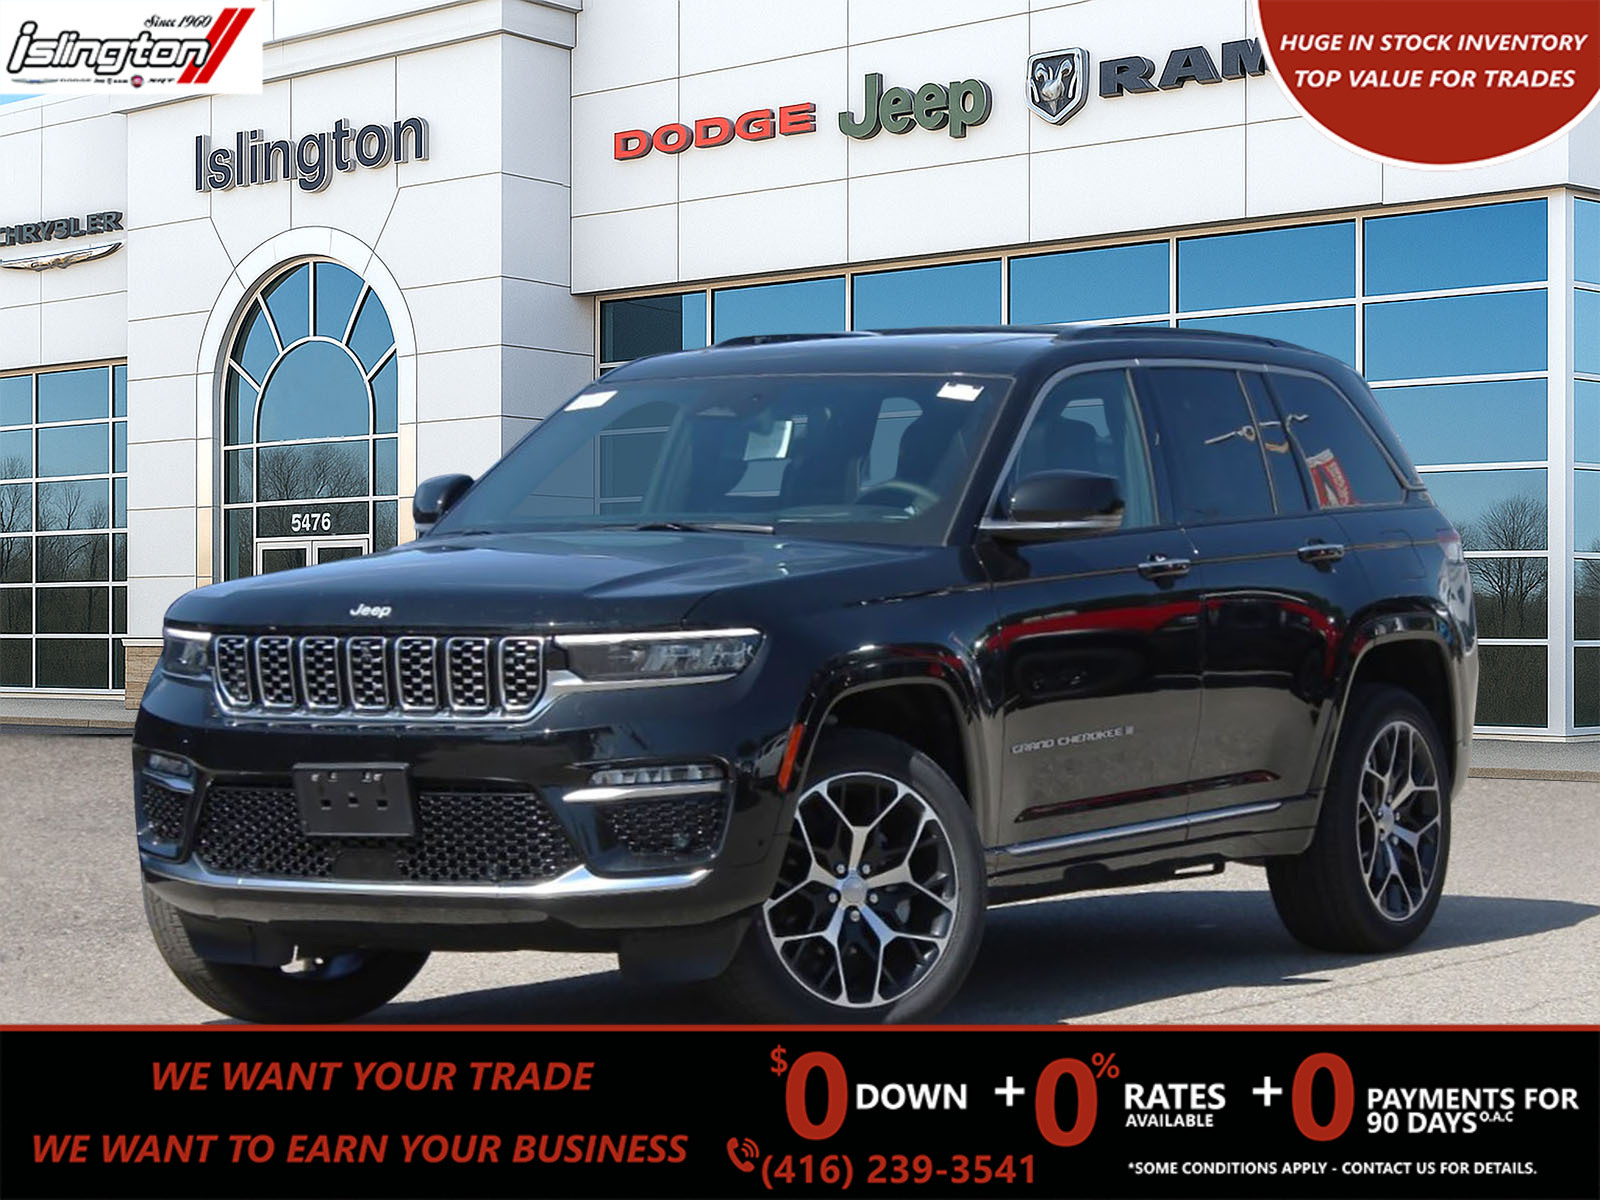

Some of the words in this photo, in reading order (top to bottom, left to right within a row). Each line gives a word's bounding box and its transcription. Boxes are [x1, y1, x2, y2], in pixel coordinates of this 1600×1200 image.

[1098, 36, 1269, 99] RAM
[613, 101, 817, 161] DODGE
[838, 72, 992, 139] Jeep
[194, 115, 430, 192] Islington
[291, 512, 332, 532] 5476
[349, 603, 392, 619] Jeep
[1011, 739, 1055, 754] GRAND
[1057, 726, 1123, 746] CHEROKEE
